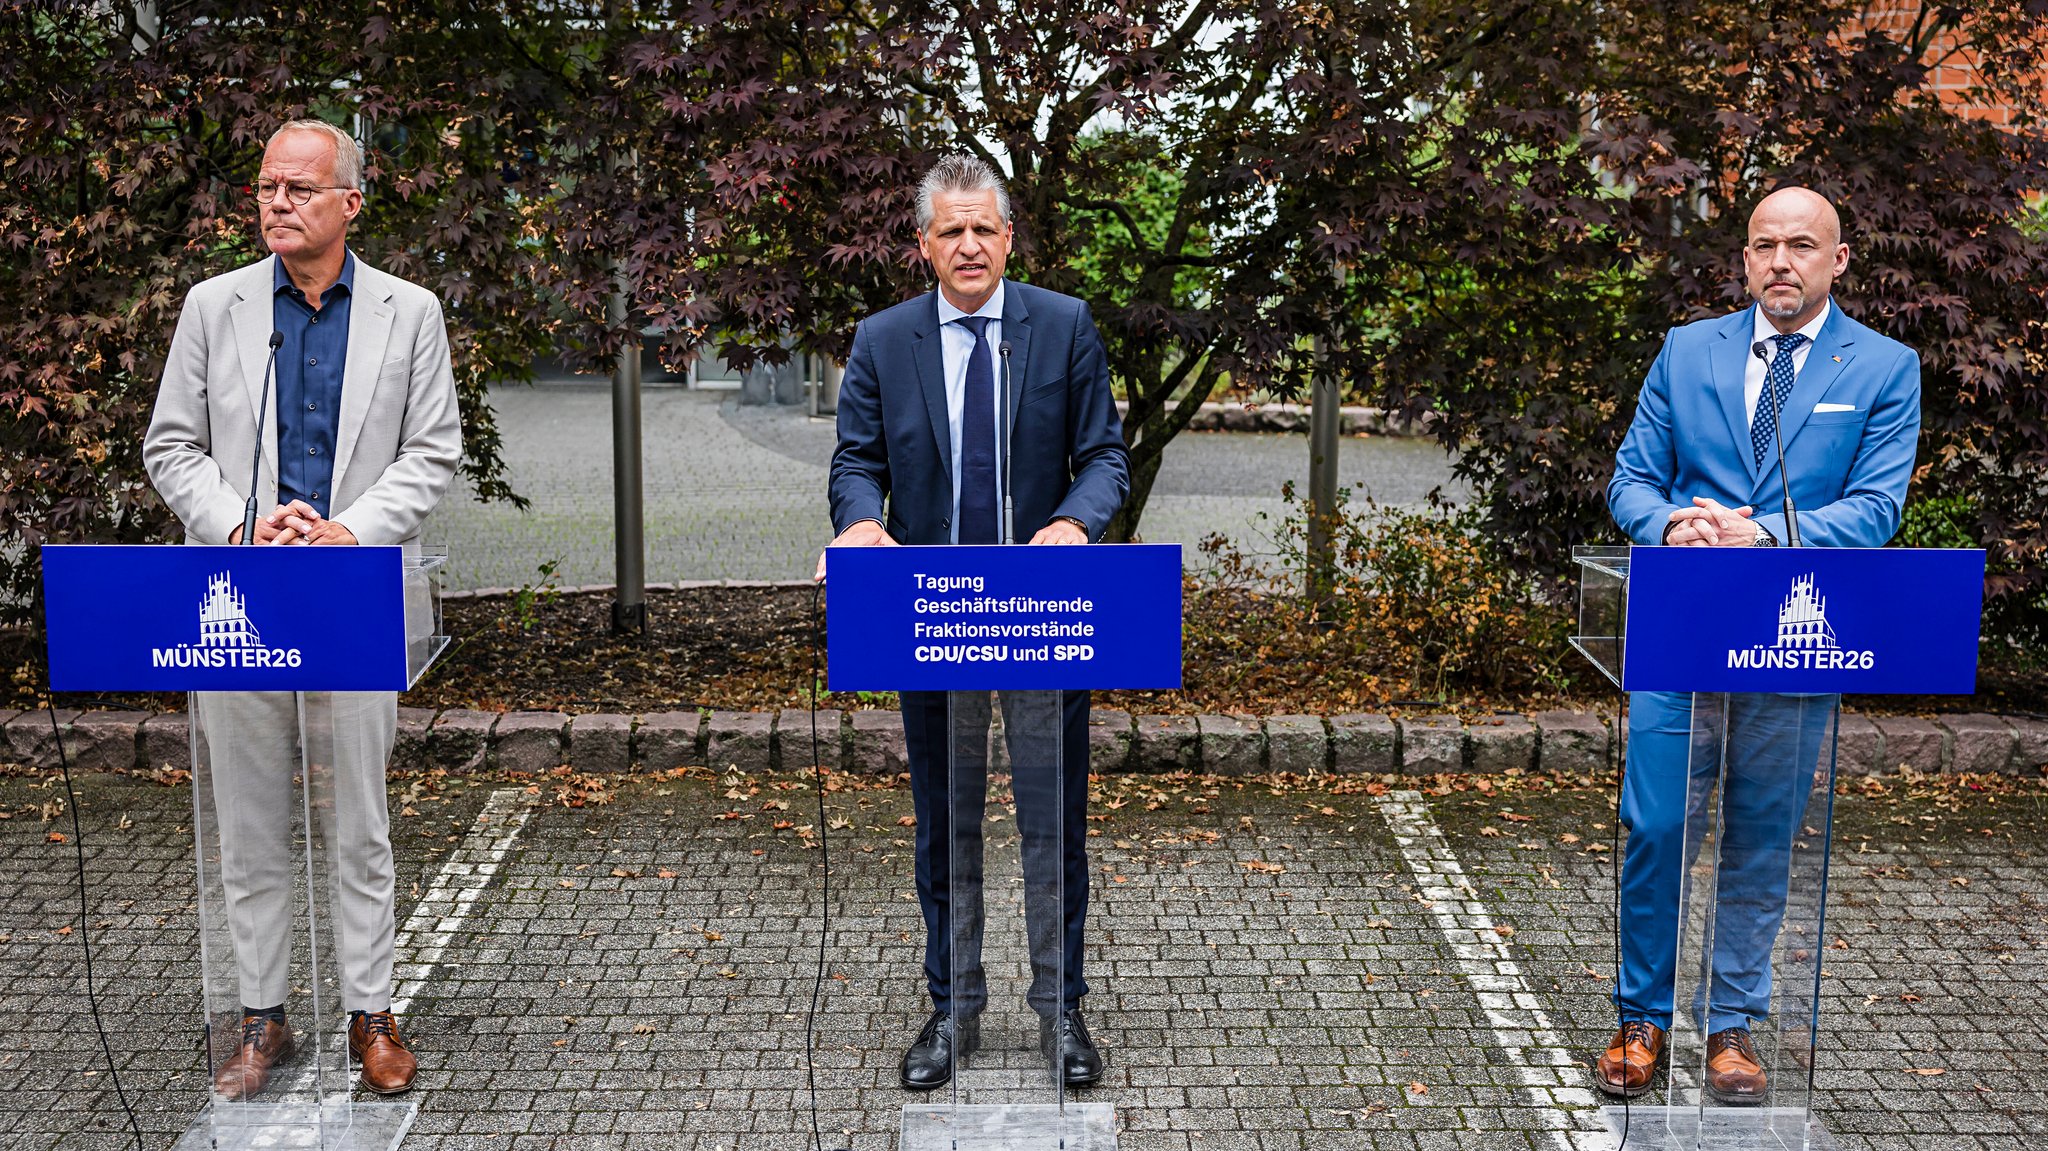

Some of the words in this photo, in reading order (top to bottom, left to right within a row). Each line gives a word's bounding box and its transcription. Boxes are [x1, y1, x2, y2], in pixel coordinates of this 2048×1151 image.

[913, 573, 984, 593] Tagung
[914, 596, 1094, 614] Geschäftsführende
[914, 621, 1095, 638] Fraktionsvorstände
[152, 643, 302, 668] MÜNSTER26
[914, 644, 1008, 664] CDU/CSU
[1013, 644, 1049, 662] und
[1053, 644, 1095, 662] SPD
[1727, 644, 1875, 670] MÜNSTER26
